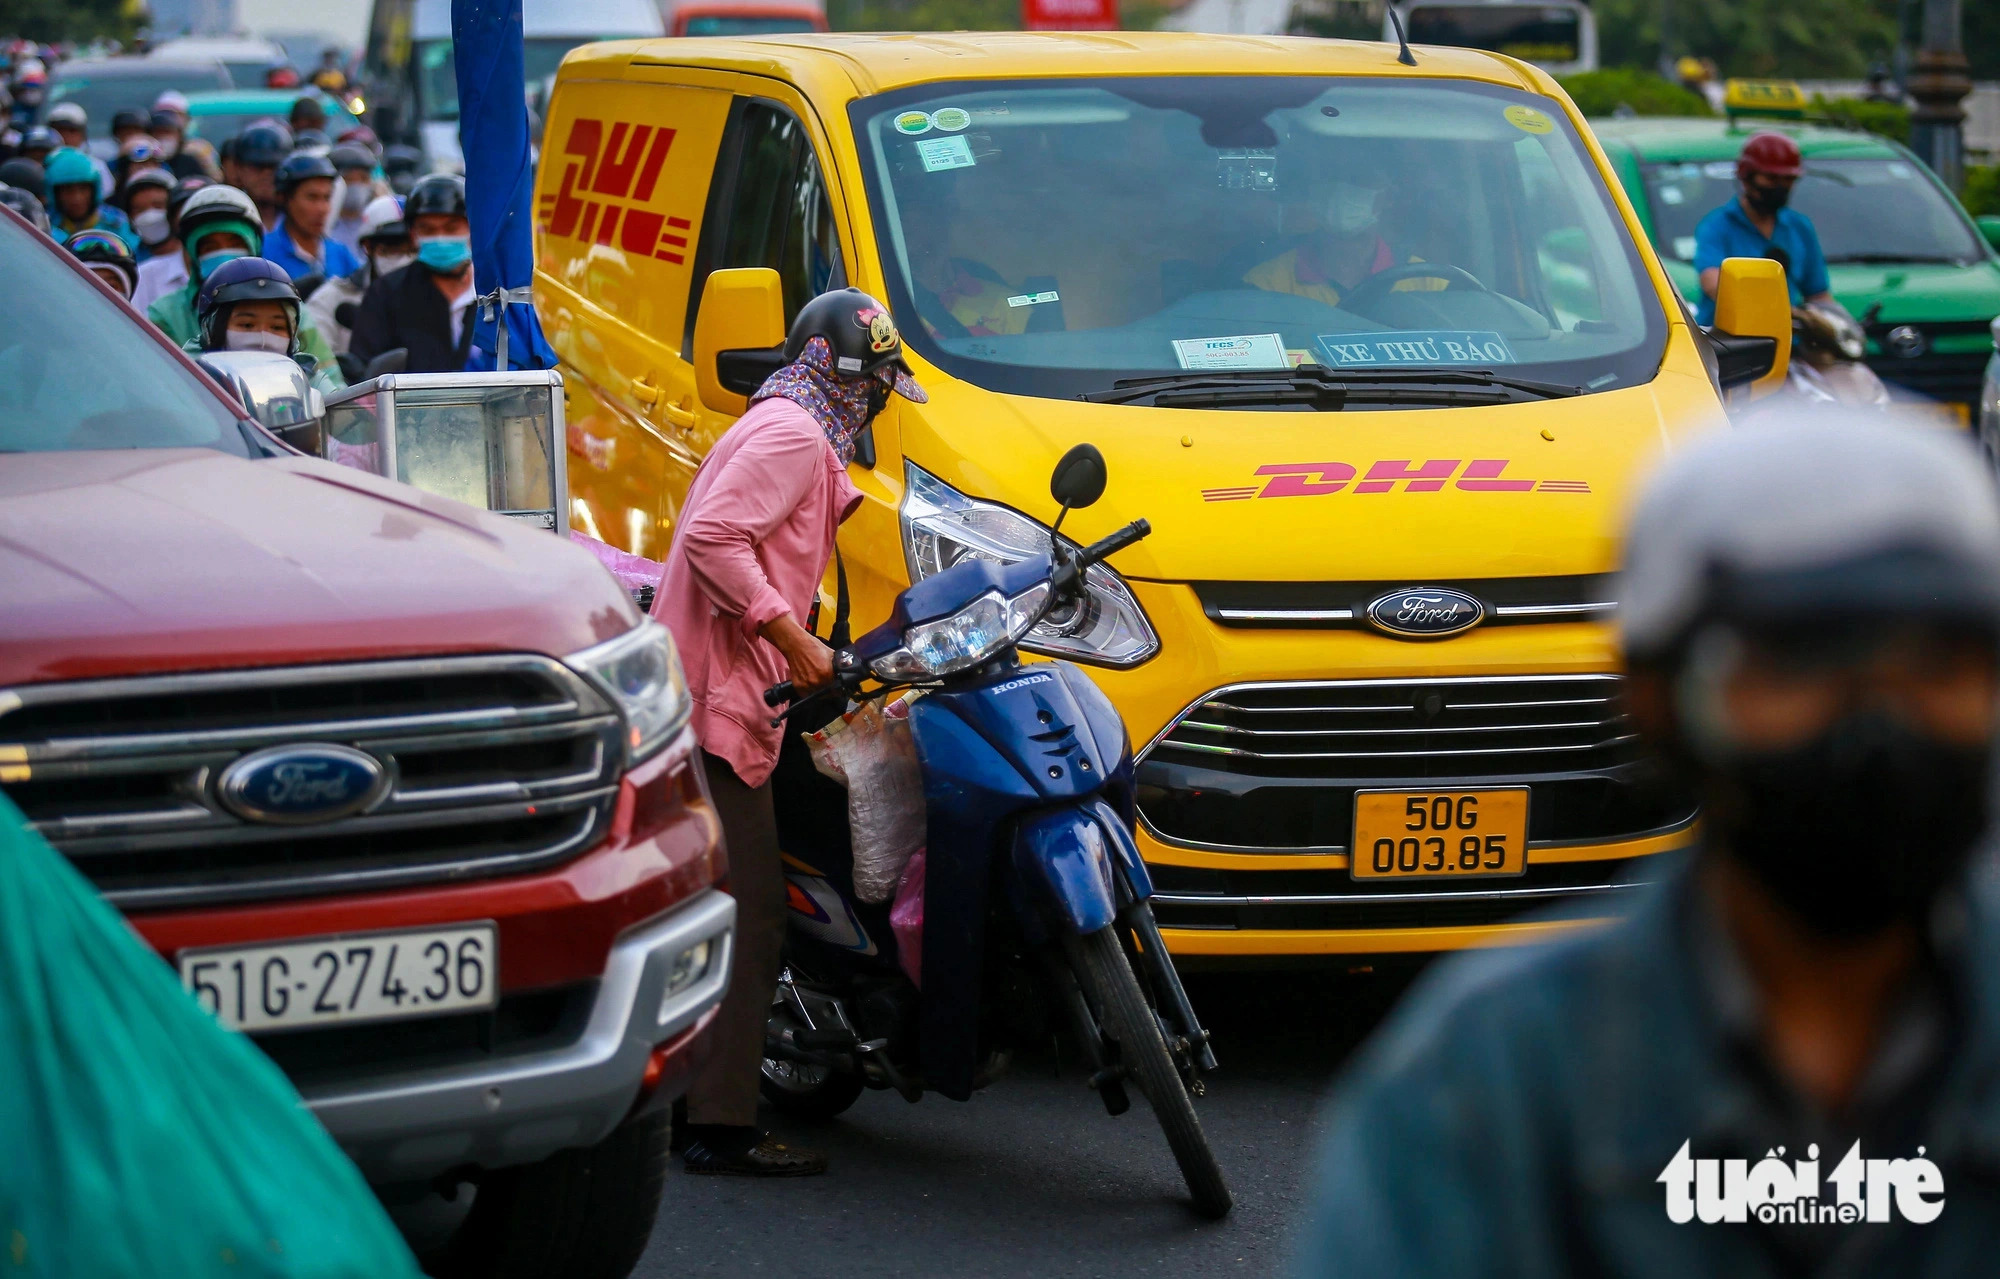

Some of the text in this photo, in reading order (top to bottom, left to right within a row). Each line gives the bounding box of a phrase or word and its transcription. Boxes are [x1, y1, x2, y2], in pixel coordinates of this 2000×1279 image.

[1205, 341, 1234, 349] TECS
[1330, 343, 1376, 363] XE
[1376, 336, 1440, 361] THƯ
[1443, 335, 1507, 362] BÁO
[1253, 459, 1537, 498] DHL
[1396, 596, 1459, 623] Ford
[992, 674, 1053, 695] HONDA
[268, 762, 348, 804] Ford
[1405, 795, 1478, 831] 50G
[1372, 834, 1507, 873] 003.85
[192, 937, 484, 1022] 51G-274.36
